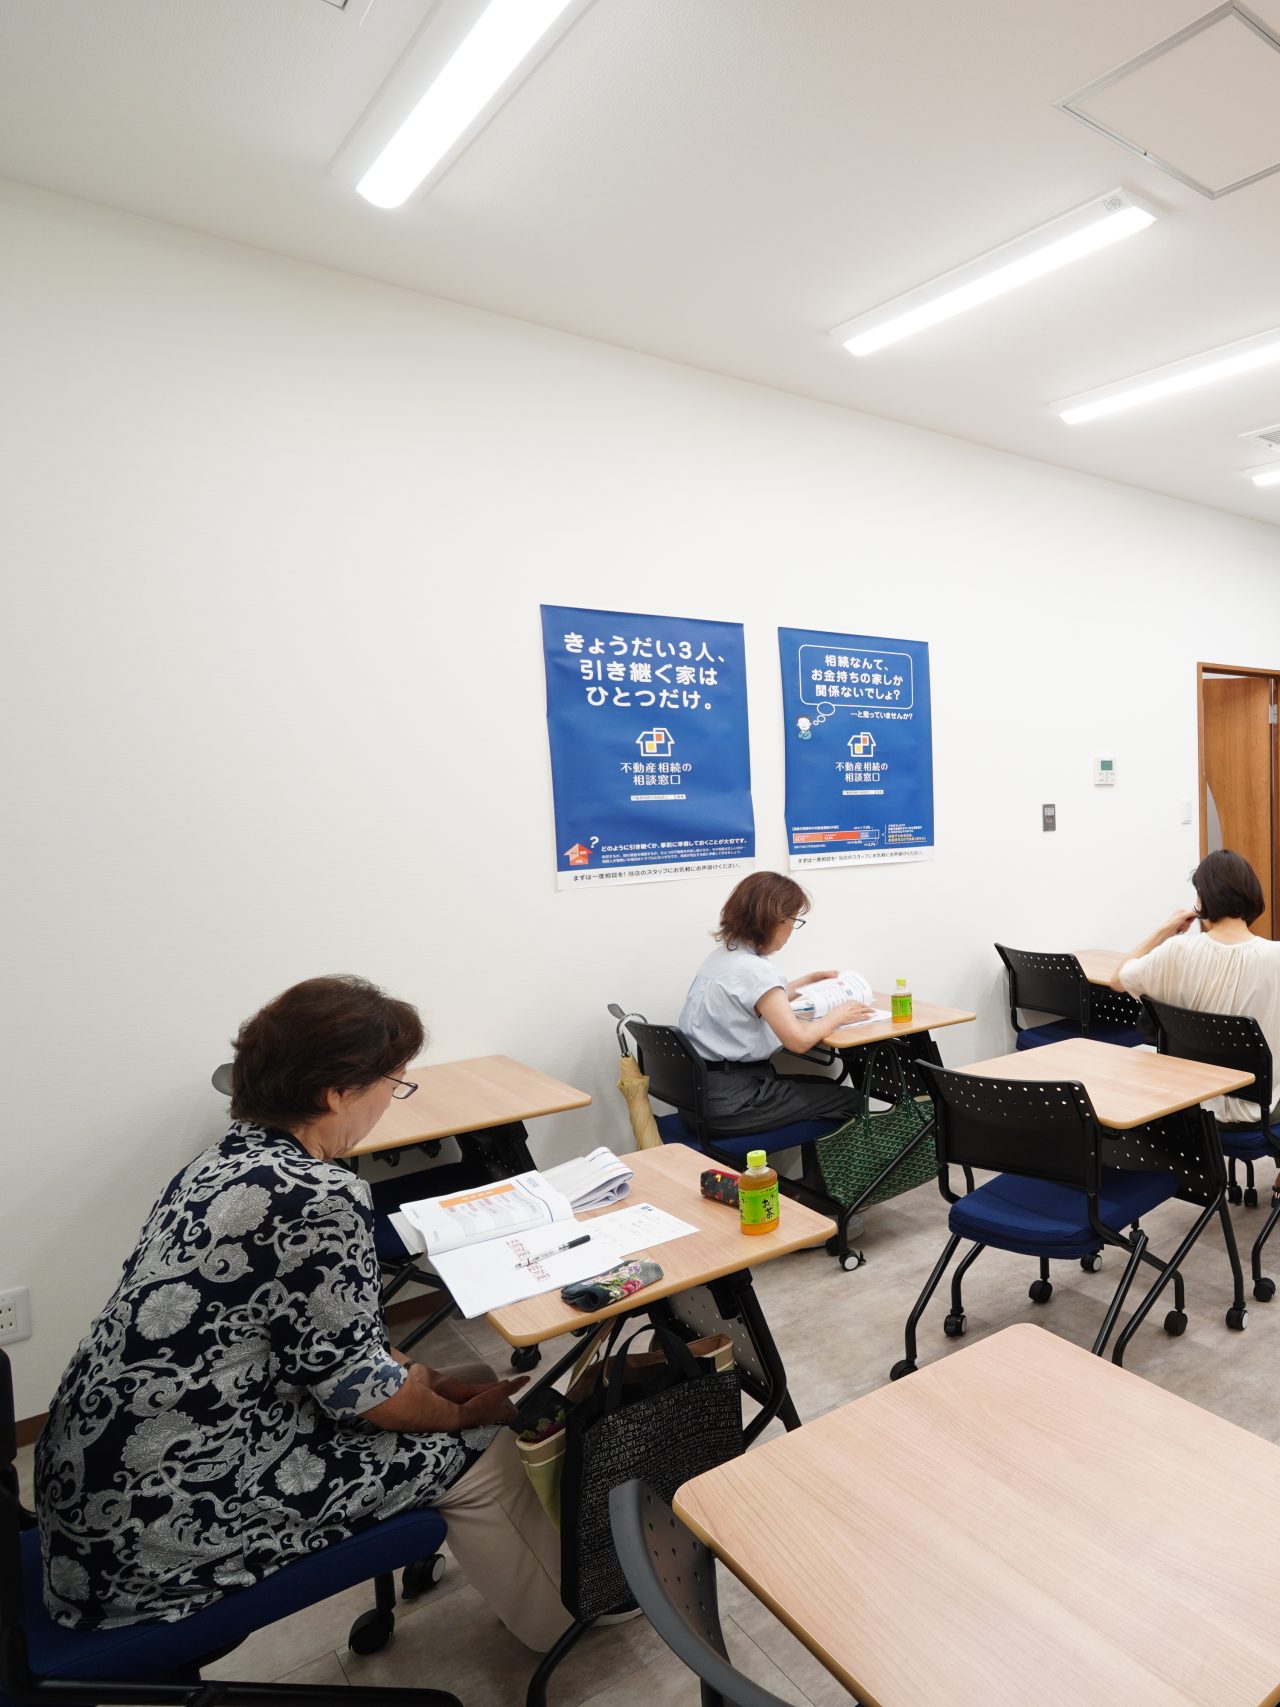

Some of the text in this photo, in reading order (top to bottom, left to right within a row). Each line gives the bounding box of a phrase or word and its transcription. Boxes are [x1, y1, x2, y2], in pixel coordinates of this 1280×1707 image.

[564, 632, 726, 663] きょうだい3人、
[825, 655, 889, 671] 相続なんて、
[580, 658, 718, 686] 引き継ぐ家は
[811, 669, 904, 687] お金持ちの家しか
[587, 686, 713, 710] ひとつだけ。
[815, 685, 901, 701] 関係ないでしょ?
[620, 762, 692, 774] 不動産相続の
[835, 761, 888, 773] 不動産相続の
[633, 774, 681, 786] 相談窓口
[844, 772, 881, 783] 相談窓口
